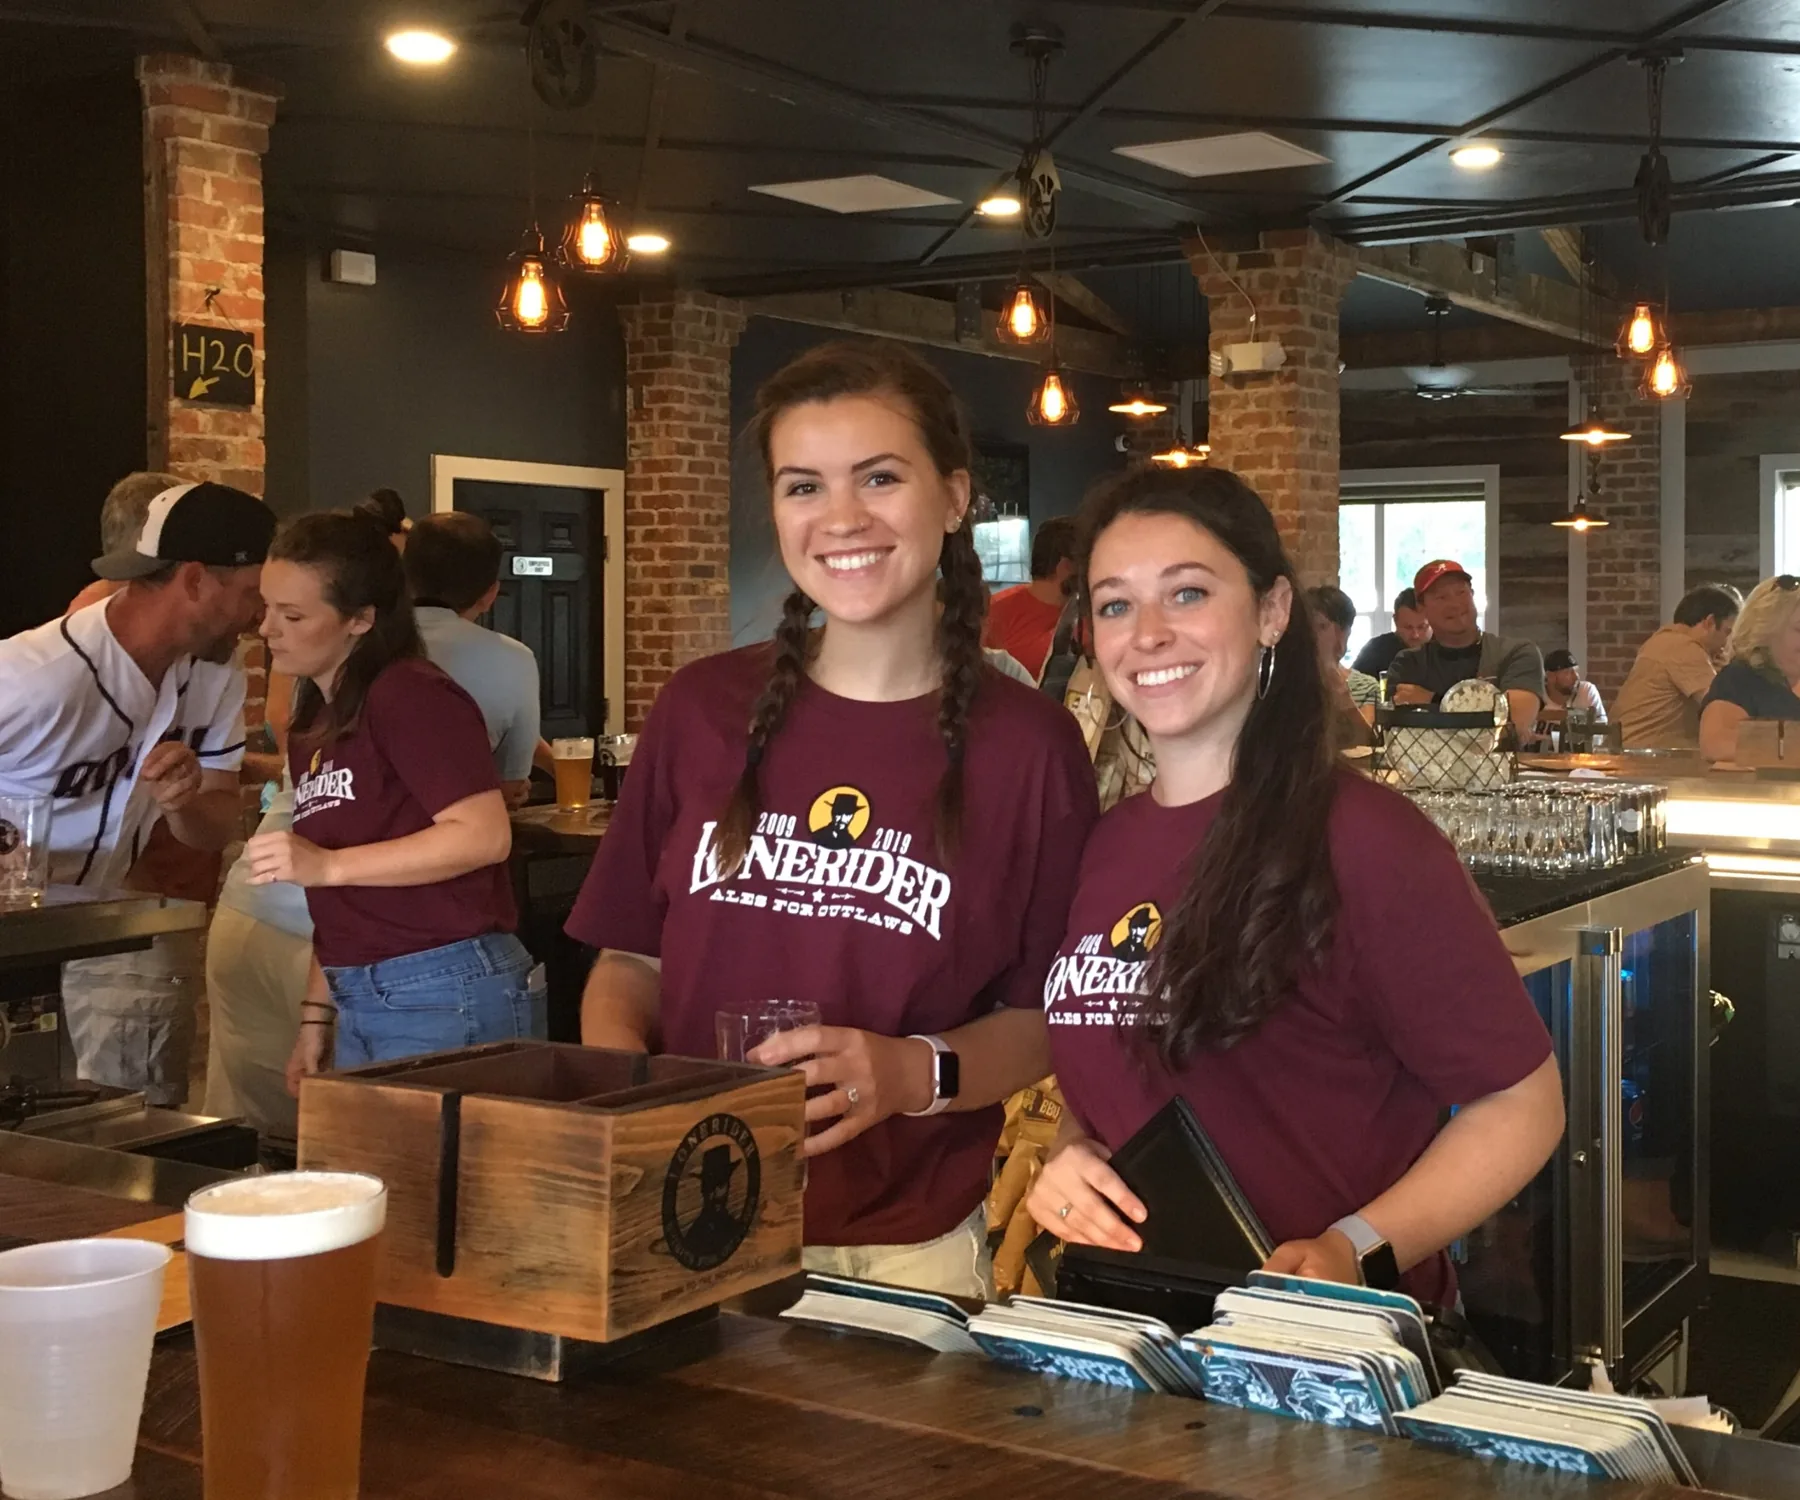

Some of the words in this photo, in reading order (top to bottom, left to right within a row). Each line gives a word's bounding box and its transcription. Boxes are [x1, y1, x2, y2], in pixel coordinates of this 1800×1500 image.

[182, 333, 255, 378] H2O
[756, 811, 797, 838] 2009
[871, 827, 912, 855] 2019
[709, 888, 768, 908] ALES
[772, 898, 814, 917] FOR
[817, 904, 914, 936] OUTLAWS
[1085, 1012, 1115, 1026] FOR
